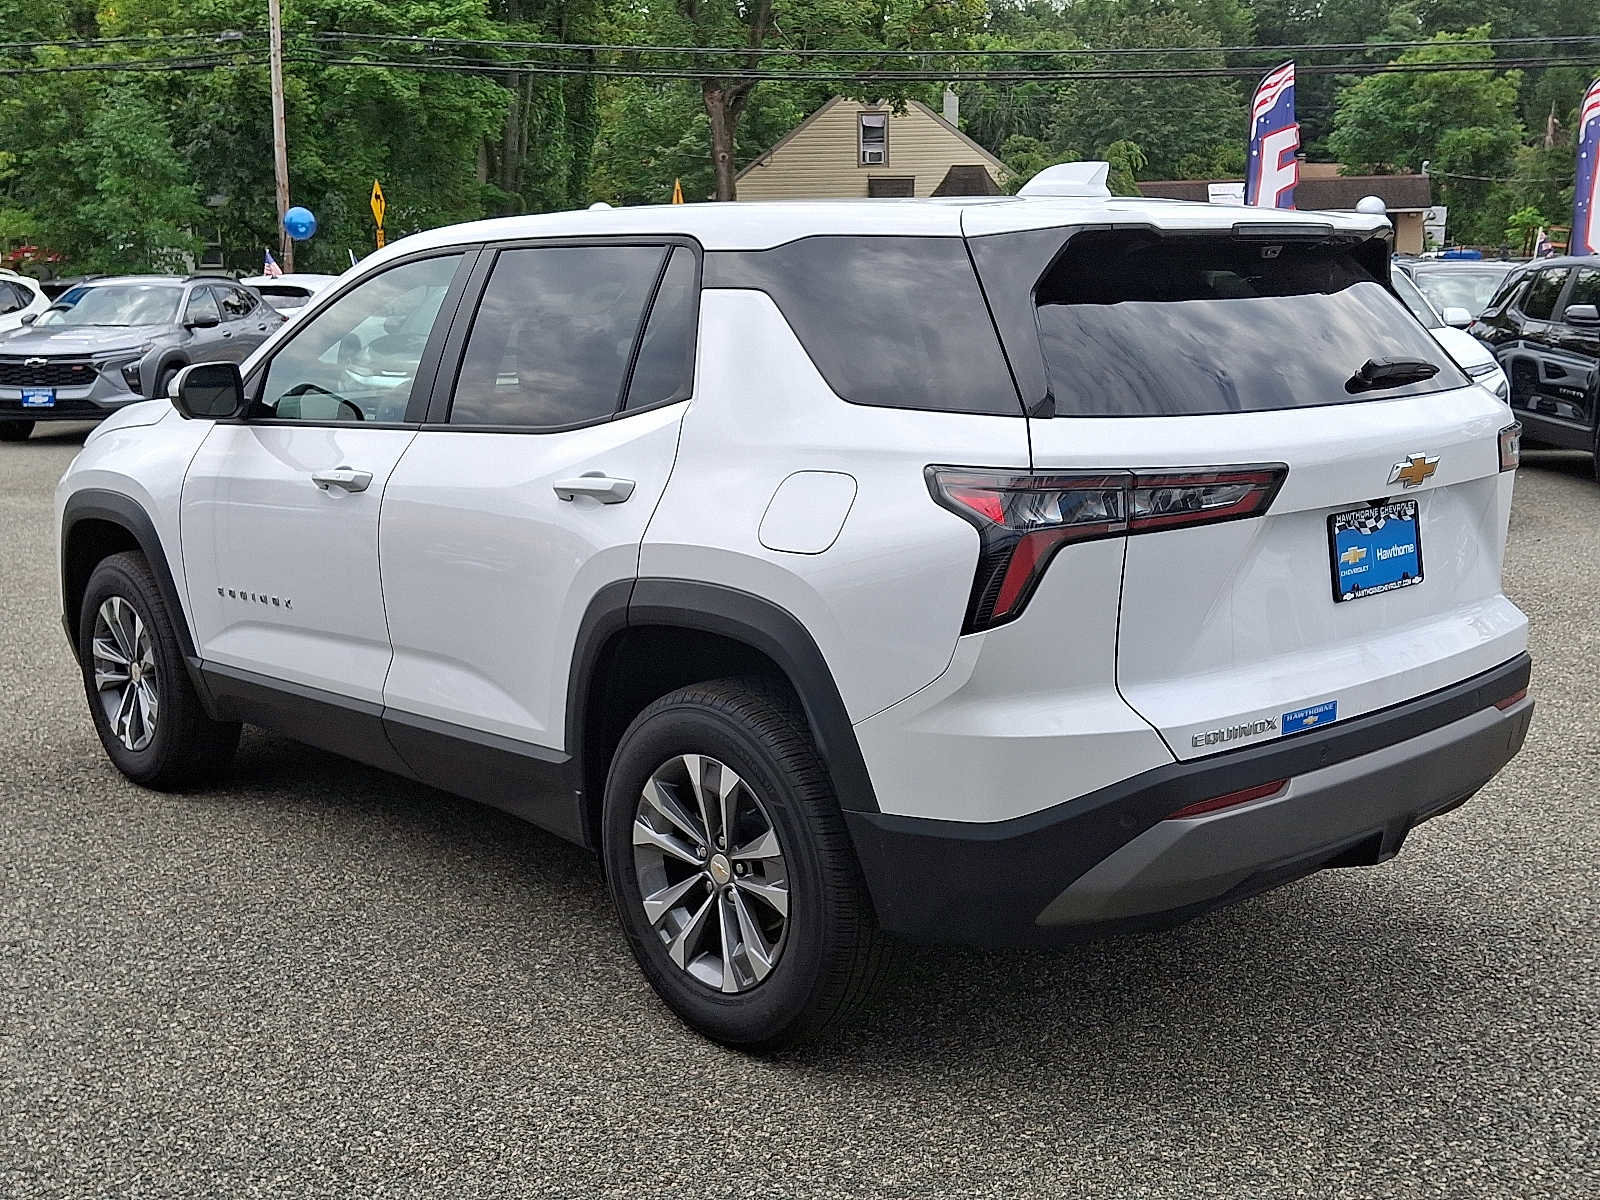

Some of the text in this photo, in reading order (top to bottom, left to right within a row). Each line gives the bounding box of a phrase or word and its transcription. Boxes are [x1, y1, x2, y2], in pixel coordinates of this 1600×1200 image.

[1336, 501, 1415, 523] HAWTHORNE CHEVROLET
[1376, 543, 1414, 560] Hawthorne
[217, 587, 293, 609] EQUINOX
[1286, 705, 1334, 721] HAWTHORNE
[1191, 716, 1279, 747] EQUINOX
